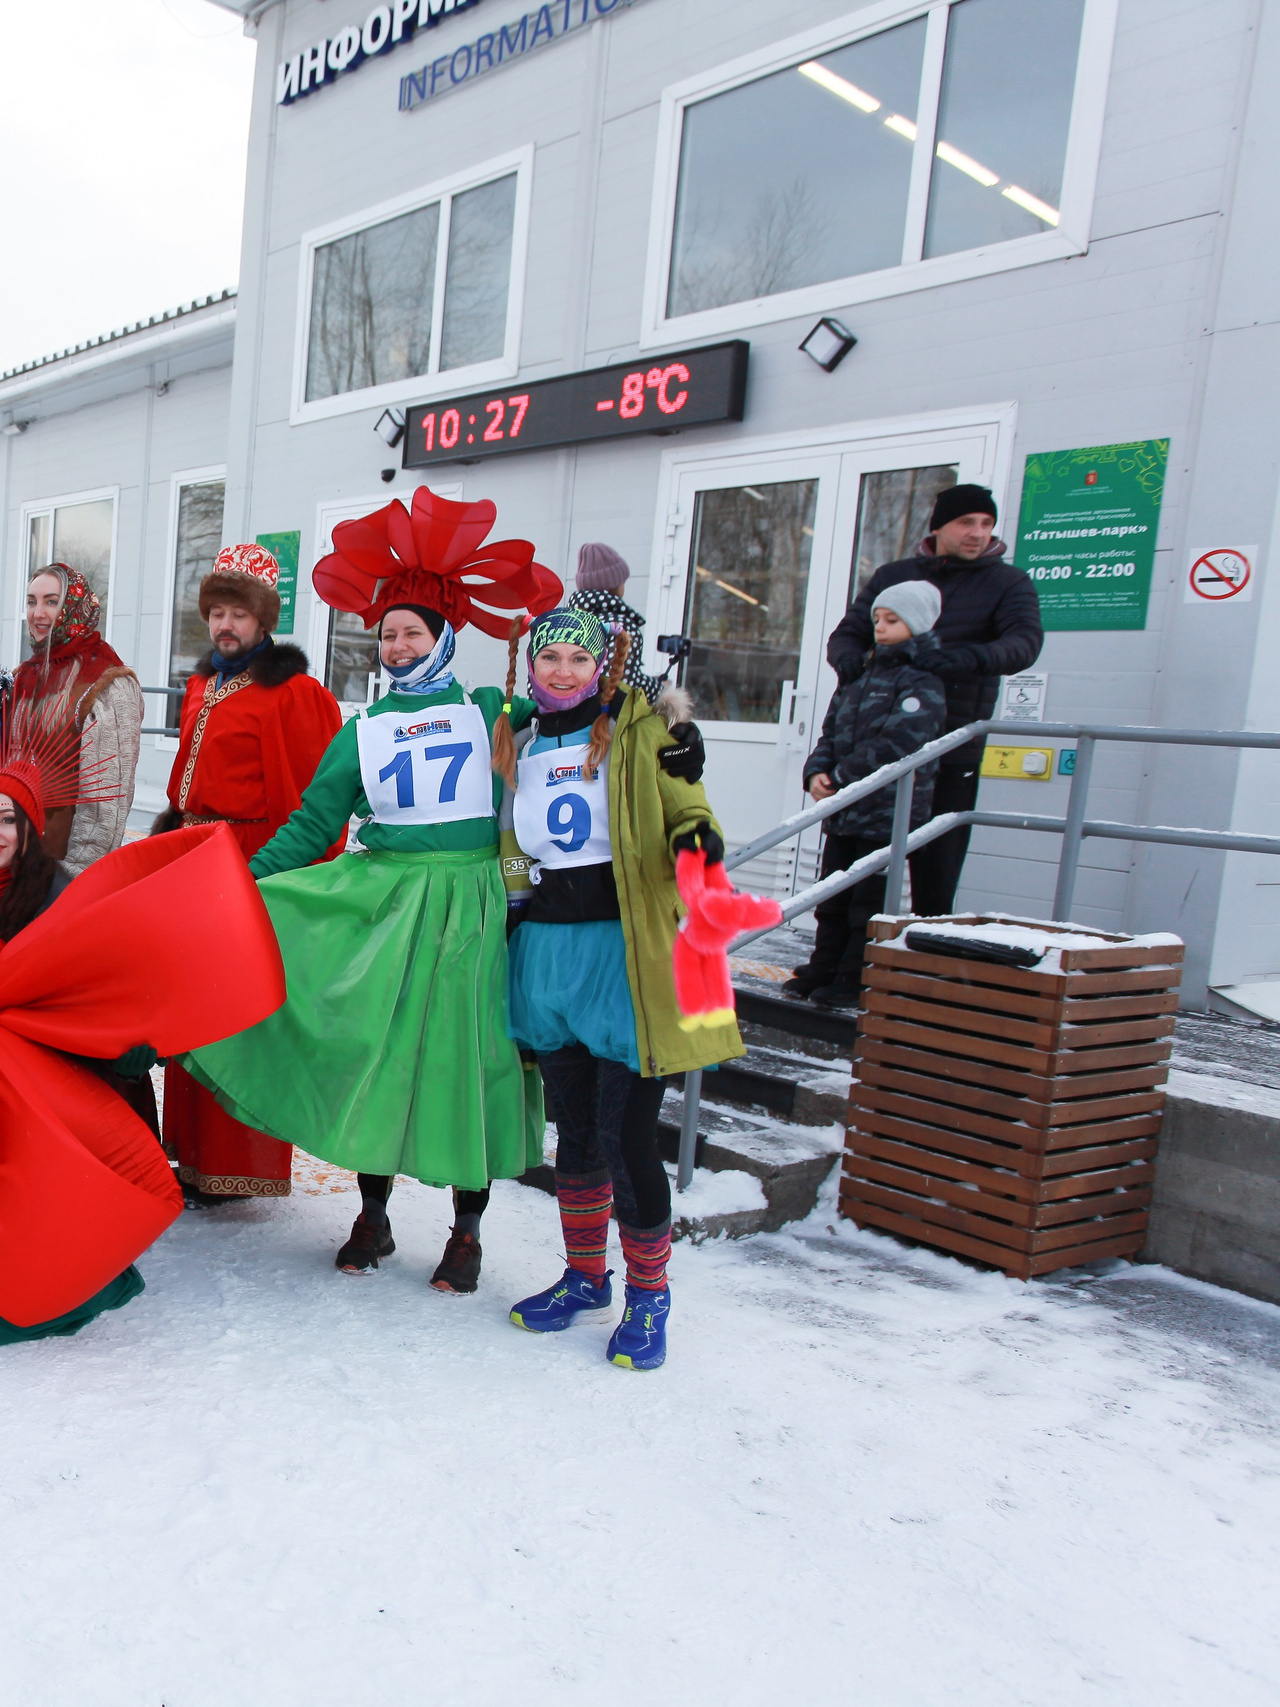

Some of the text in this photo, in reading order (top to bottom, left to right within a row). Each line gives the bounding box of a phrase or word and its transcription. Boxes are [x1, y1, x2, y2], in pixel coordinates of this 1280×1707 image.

[422, 394, 530, 451] 10:27
[1023, 524, 1148, 541] «Татышев-парк»
[1026, 565, 1072, 581] 10:00
[1084, 562, 1136, 579] 22:00
[1028, 553, 1073, 562] Основные
[1074, 552, 1097, 560] часы
[378, 741, 473, 809] 17
[546, 792, 592, 853] 9
